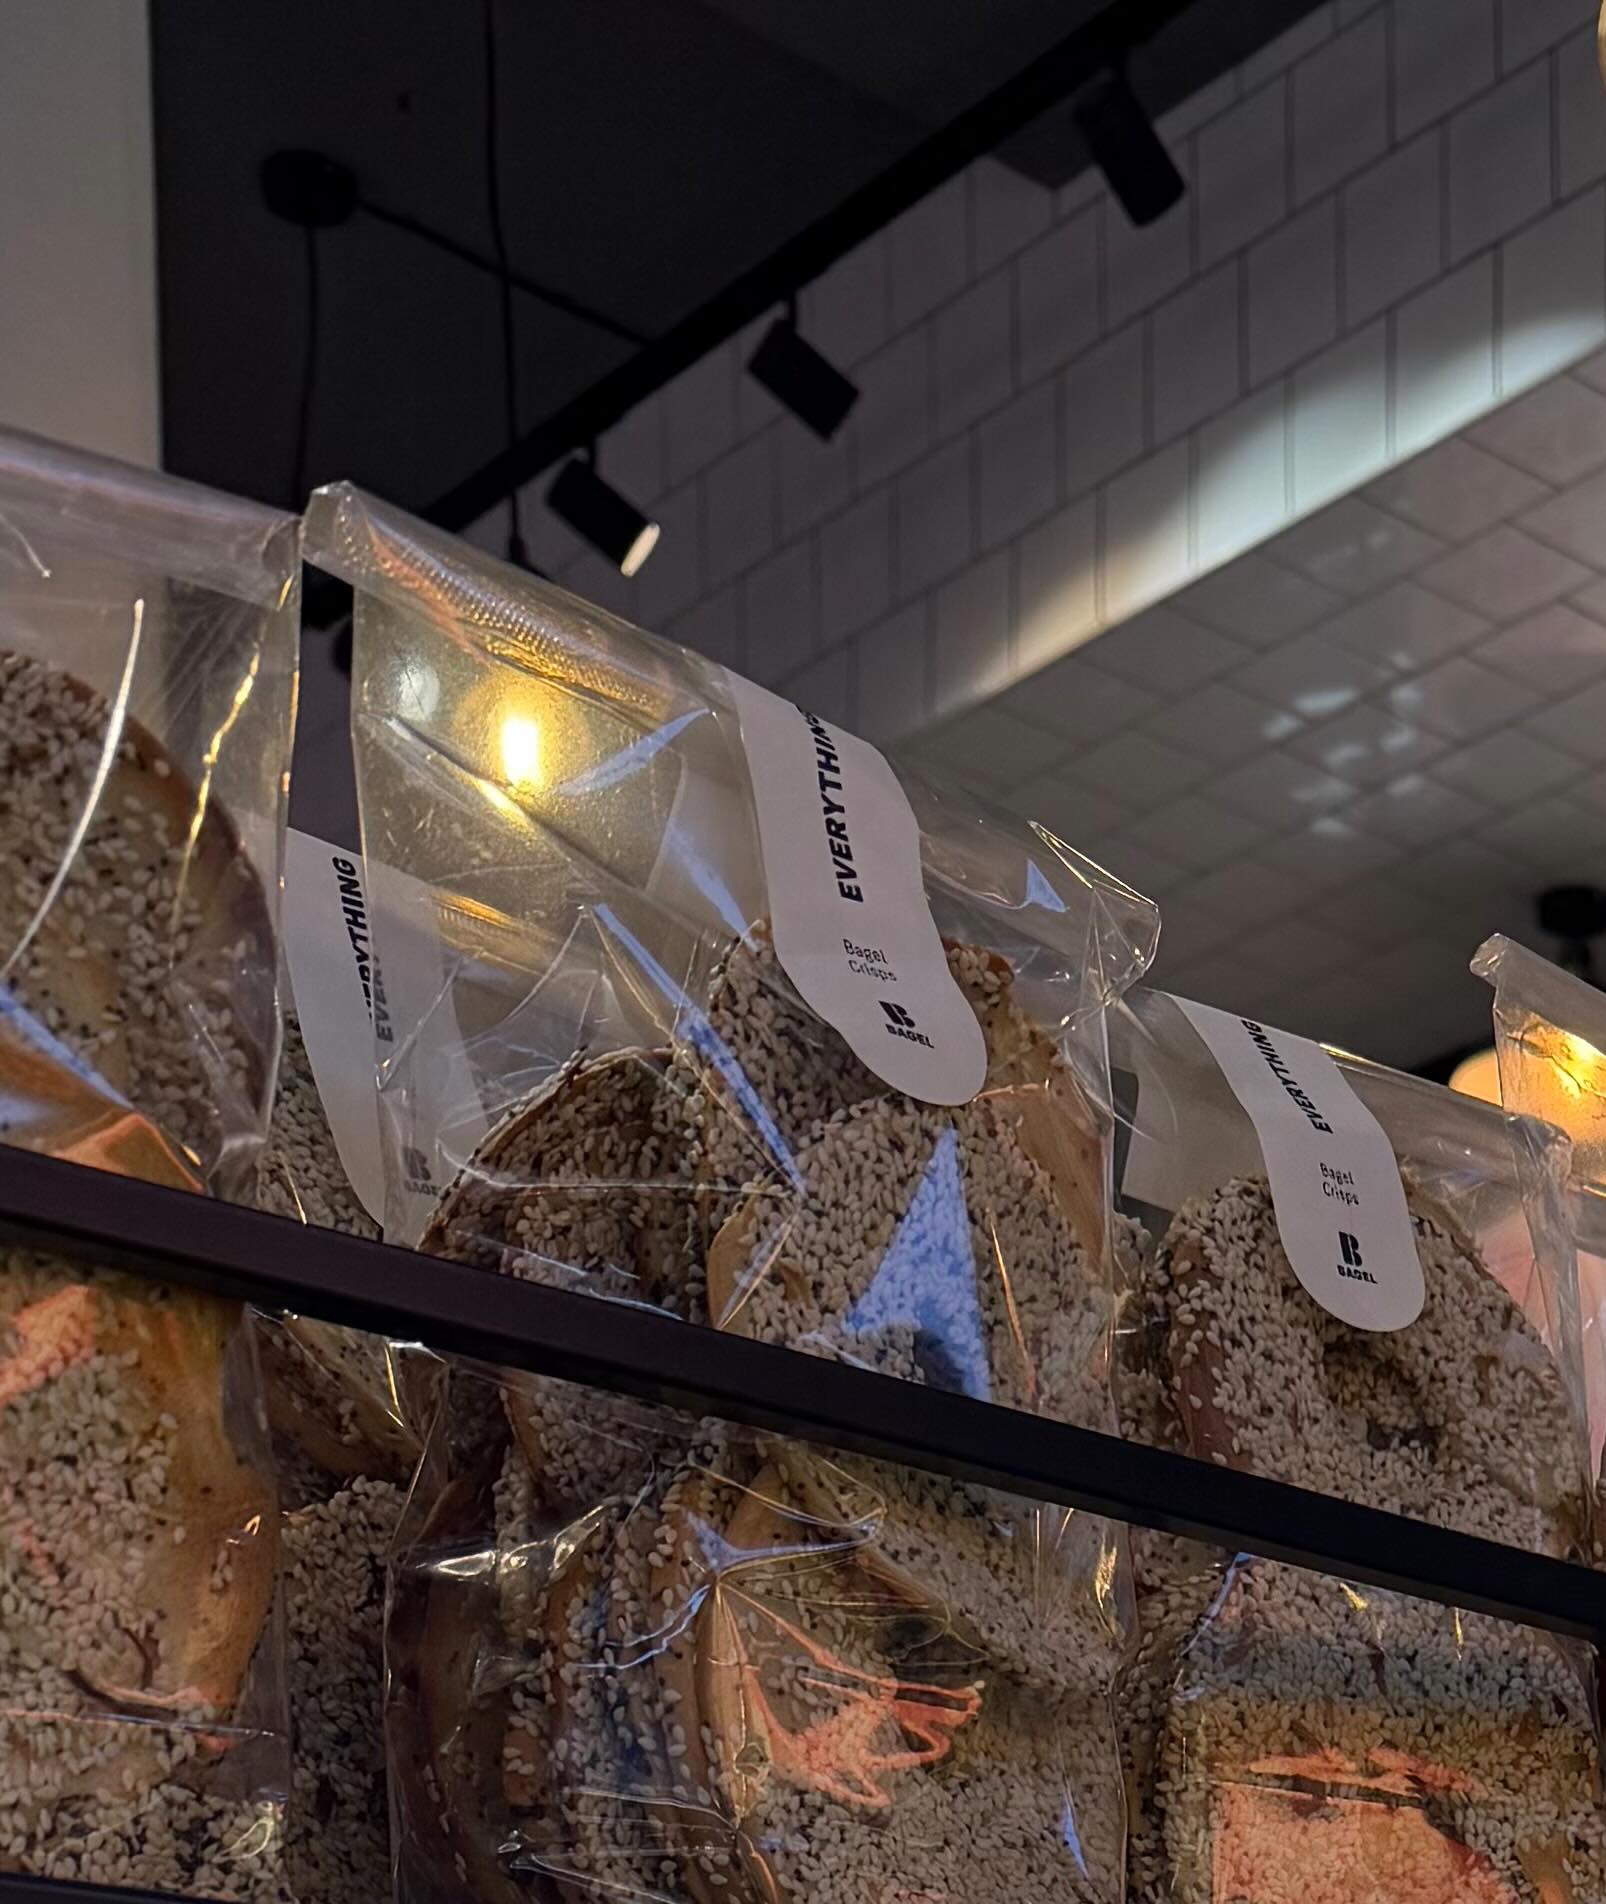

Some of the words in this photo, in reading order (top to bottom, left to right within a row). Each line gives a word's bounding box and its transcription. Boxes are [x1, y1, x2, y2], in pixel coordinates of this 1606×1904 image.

[843, 938, 888, 964] Bagel
[848, 959, 897, 982] Crisps
[885, 1024, 935, 1048] BAGEL
[1241, 1019, 1333, 1134] EVERYTHING
[1320, 1162, 1354, 1185] Bagel
[1322, 1182, 1359, 1205] Crisps
[1337, 1265, 1378, 1284] BAGEL
